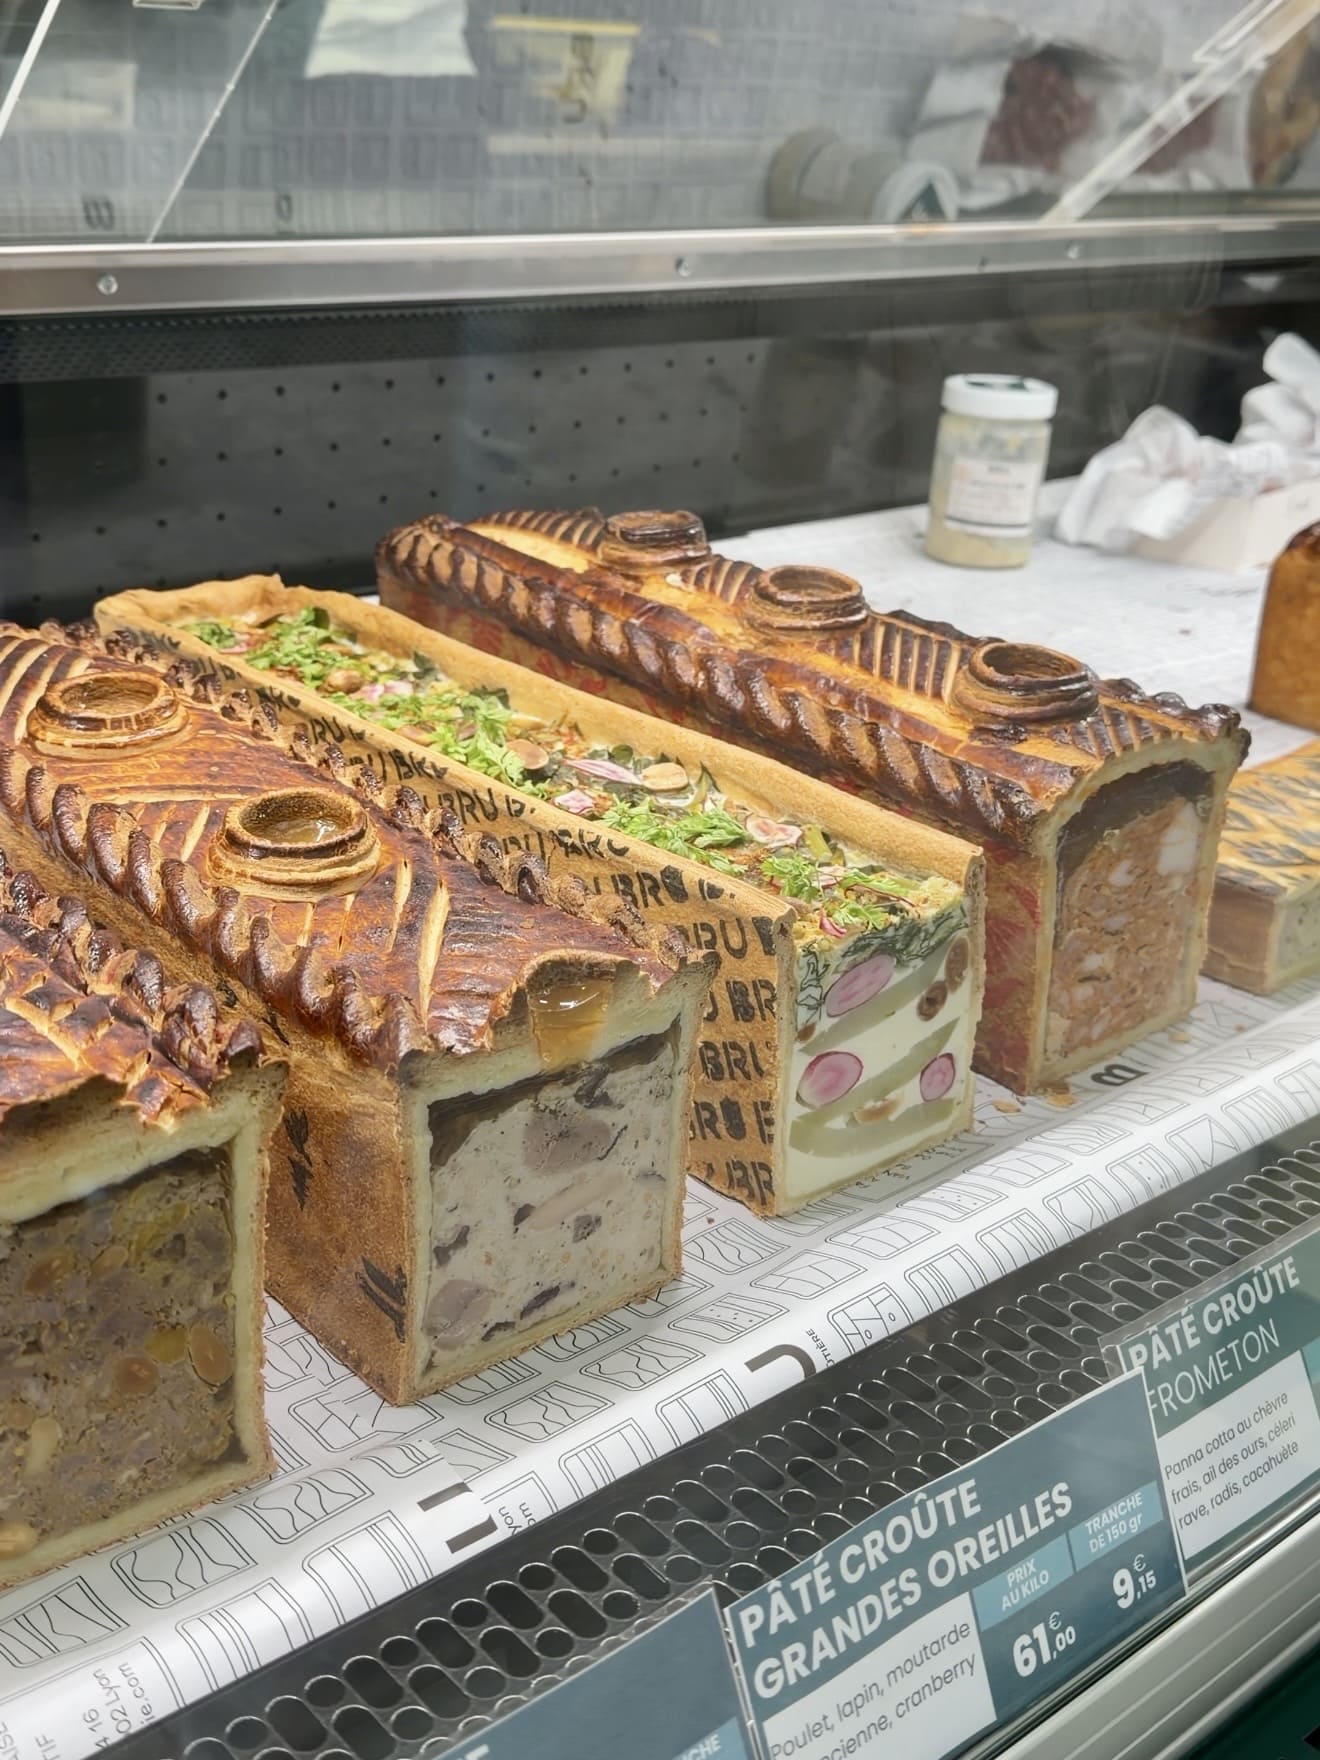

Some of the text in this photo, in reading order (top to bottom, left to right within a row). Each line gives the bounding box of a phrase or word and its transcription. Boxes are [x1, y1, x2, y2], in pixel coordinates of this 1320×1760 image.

[1128, 1255, 1300, 1370] PÂTÉ CROÛTE
[1164, 1392, 1288, 1480] Panna cotta au chèvre
[1171, 1411, 1296, 1505] frais, ail des ours, céleri
[1085, 1491, 1144, 1535] TRANCHE
[1178, 1440, 1299, 1531] rave, radis, cacahuète
[739, 1478, 981, 1649] PÂTÉ CROÛTE
[1007, 1557, 1037, 1587] PRIX
[1089, 1512, 1143, 1553] DE 150 gr
[753, 1481, 1073, 1699] GRANDES OREILLES
[1001, 1569, 1050, 1611] AU KILO
[770, 1621, 971, 1760] Poulet, lapin, moutarde
[895, 1653, 977, 1719] cranberry
